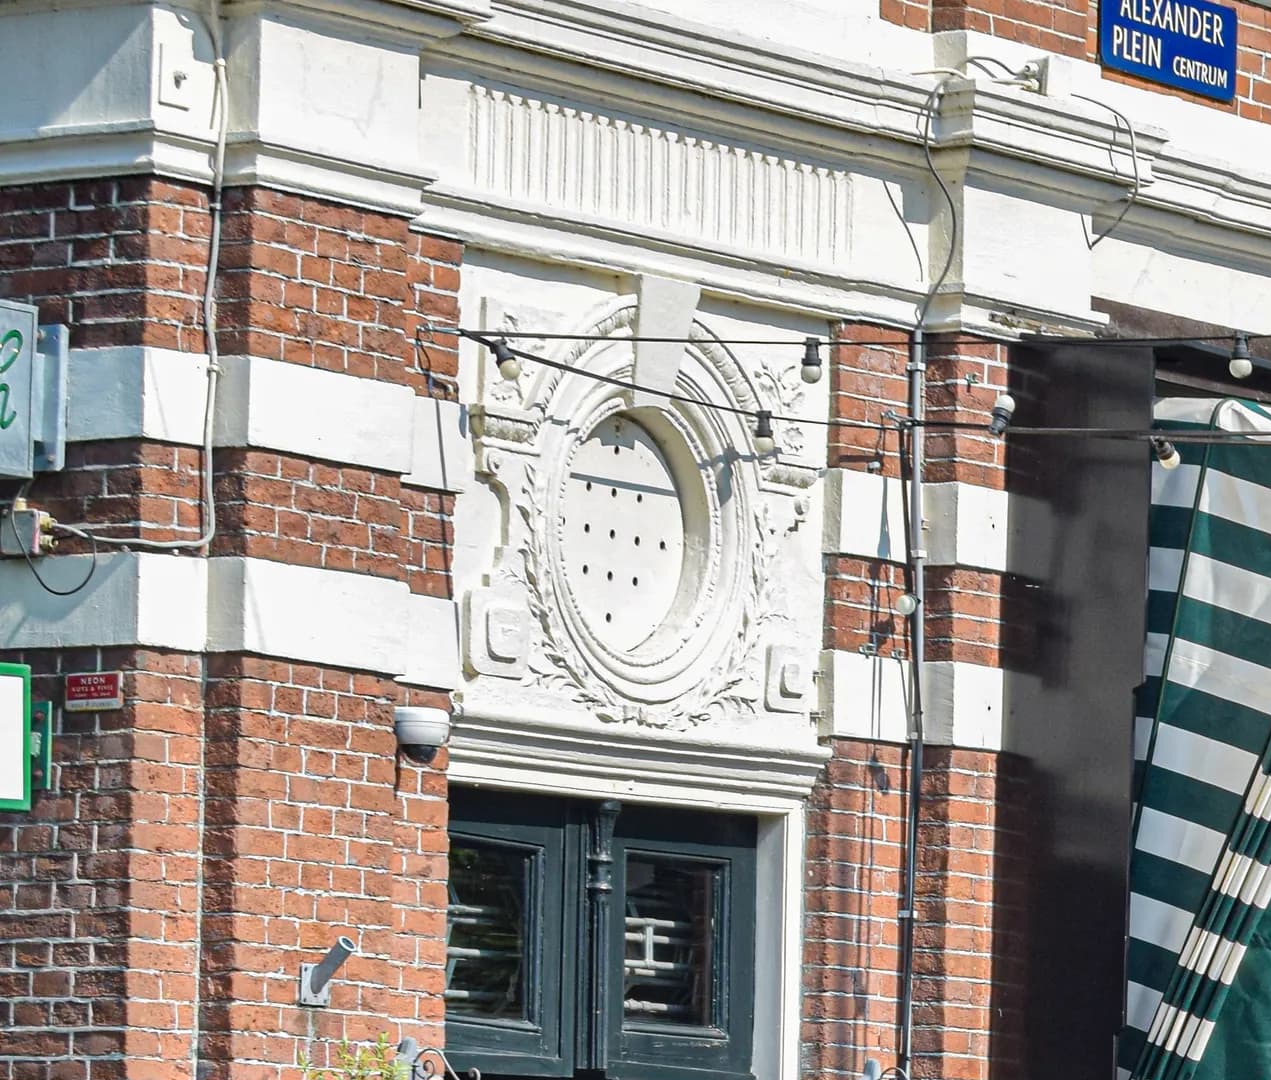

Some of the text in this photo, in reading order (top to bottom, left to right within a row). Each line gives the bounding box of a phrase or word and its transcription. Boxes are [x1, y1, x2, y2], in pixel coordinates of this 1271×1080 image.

[1120, 0, 1225, 47] ALEXANDER
[1112, 24, 1228, 89] PLEIN CENTRUM
[80, 677, 106, 685] NEON
